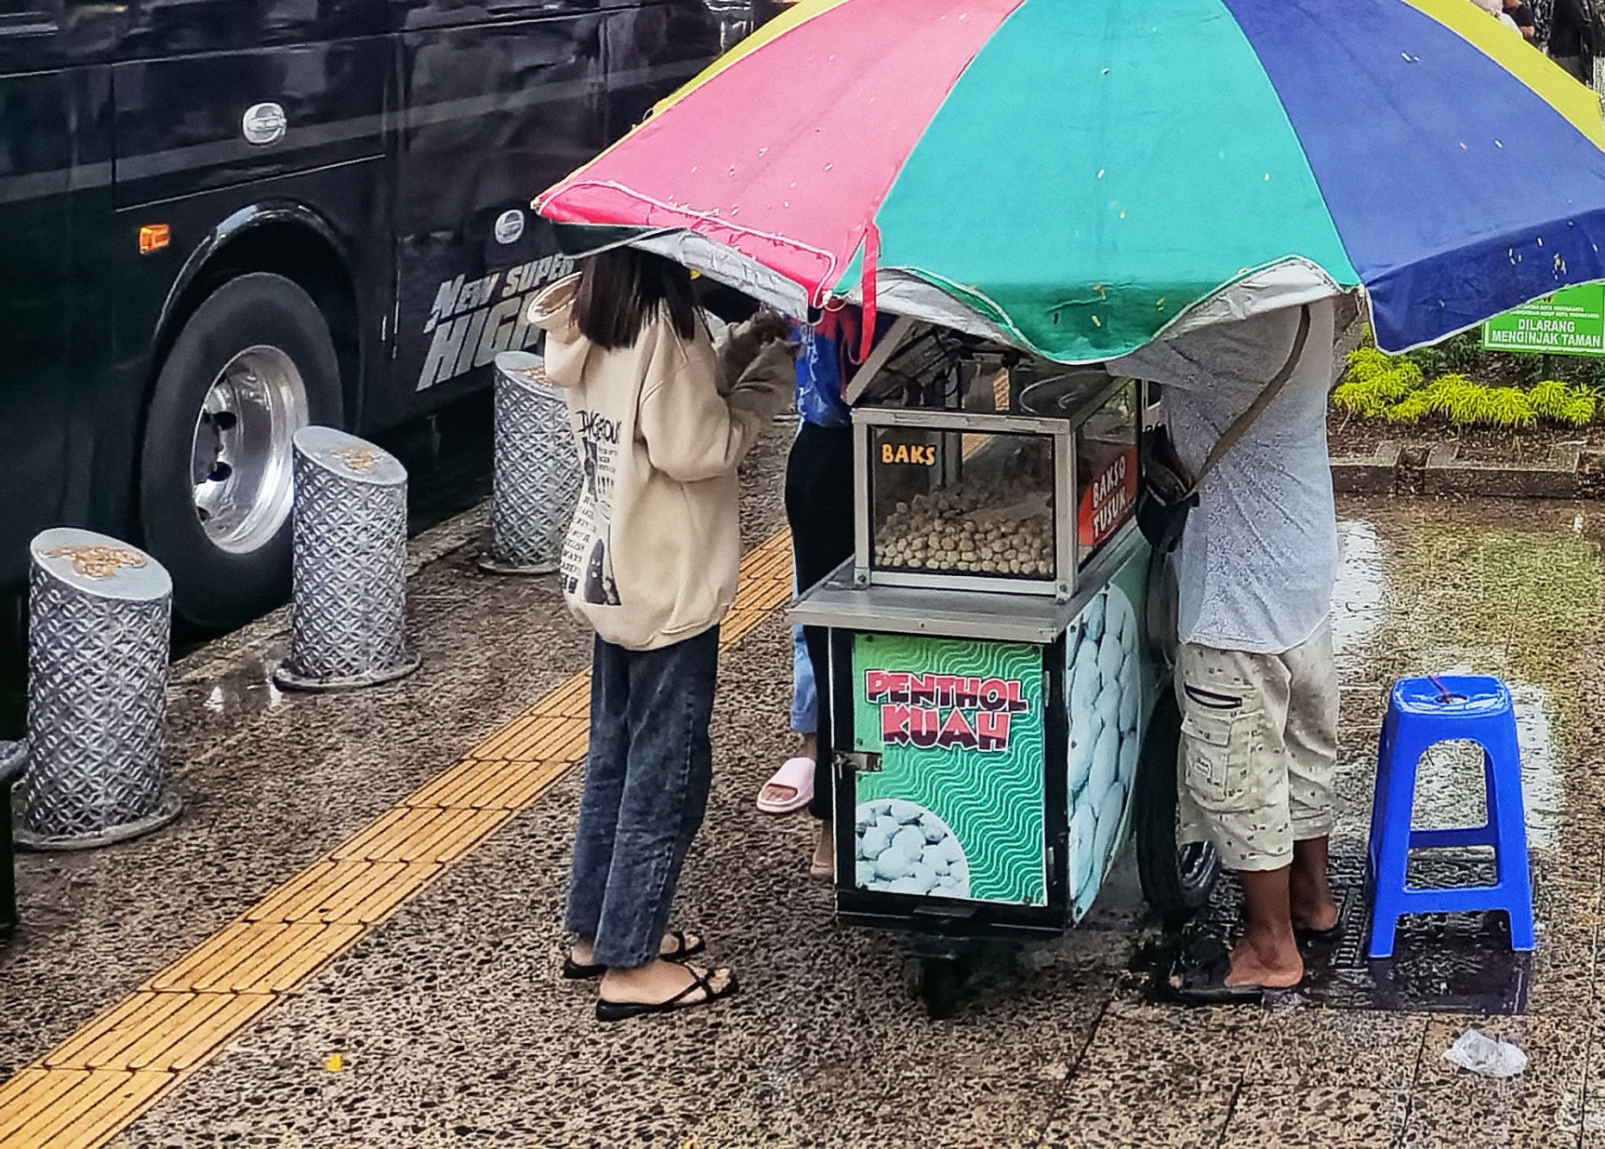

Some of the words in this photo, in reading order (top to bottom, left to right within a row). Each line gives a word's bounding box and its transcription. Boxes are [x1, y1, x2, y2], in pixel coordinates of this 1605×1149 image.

[502, 252, 575, 299] SUPER
[1492, 330, 1558, 345] MENGINJAK
[1561, 334, 1601, 347] TAMAN
[1518, 319, 1576, 333] DILARANG
[881, 443, 936, 465] BAKS
[1092, 455, 1126, 509] BAKSO
[1093, 485, 1127, 538] TUSUK
[866, 669, 1030, 714] PENTHOL
[881, 703, 1012, 753] KUAH
